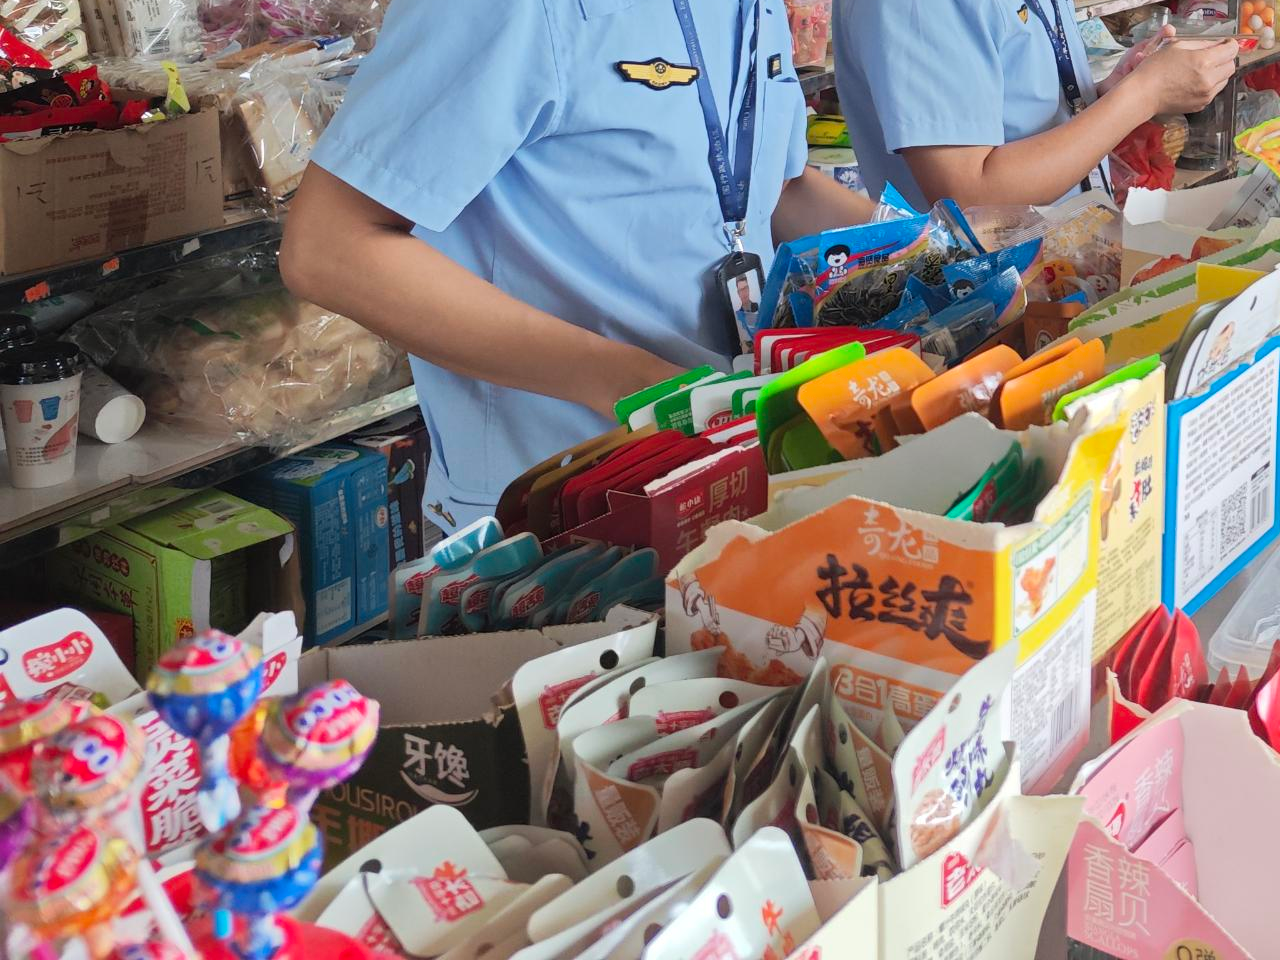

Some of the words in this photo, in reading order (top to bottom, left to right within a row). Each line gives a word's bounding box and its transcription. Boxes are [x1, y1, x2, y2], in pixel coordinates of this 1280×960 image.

[709, 466, 749, 513] 厚切
[402, 733, 470, 788] 牙馋
[325, 783, 418, 824] OUSIRO
[1083, 843, 1151, 897] 香辣
